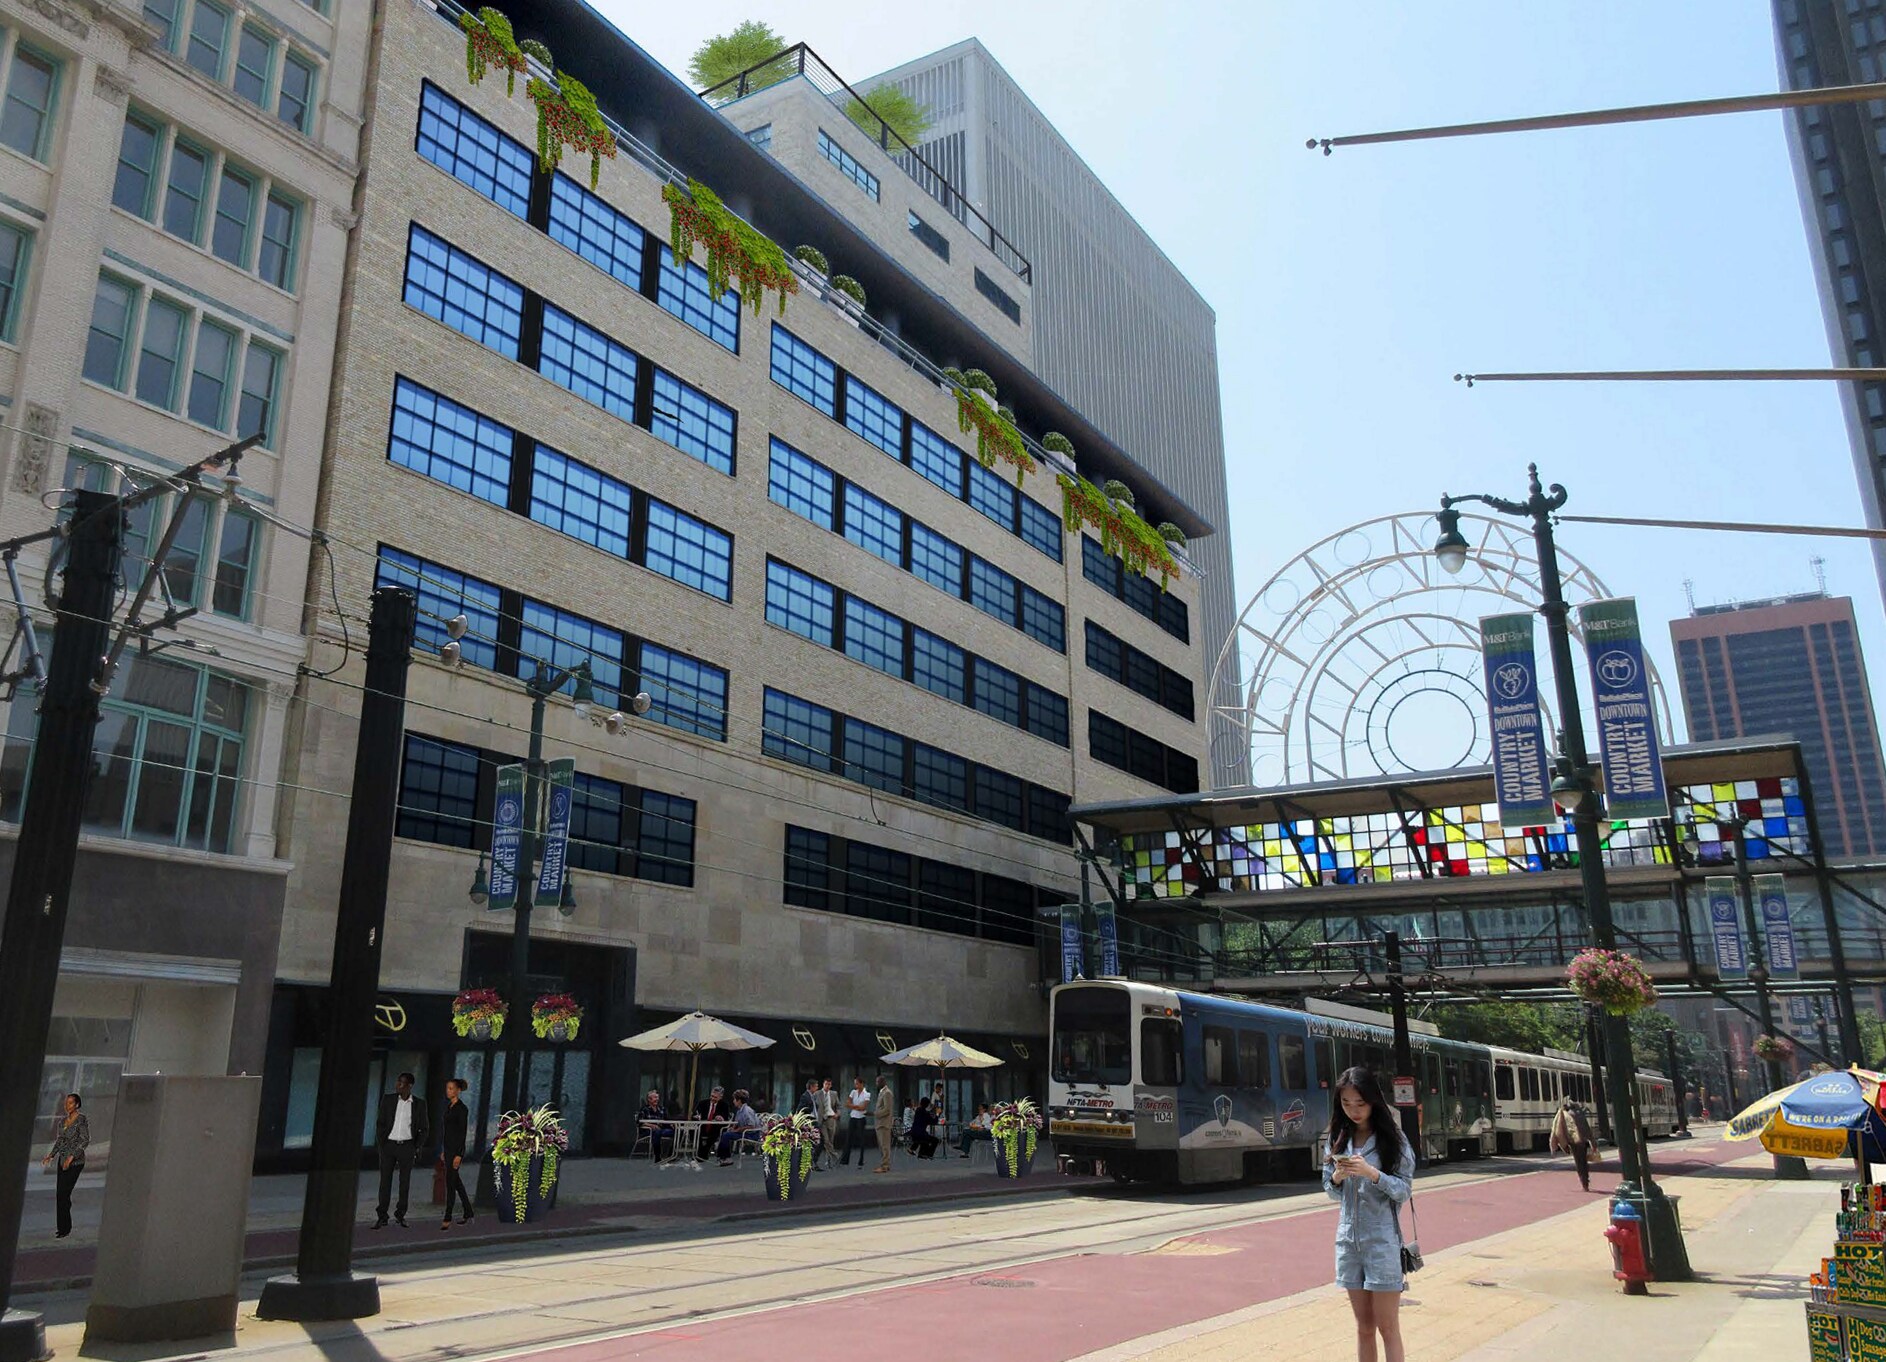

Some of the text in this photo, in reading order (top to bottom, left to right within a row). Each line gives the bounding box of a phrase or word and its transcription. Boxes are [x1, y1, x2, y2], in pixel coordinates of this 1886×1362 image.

[1599, 703, 1648, 720] DOWNTOWN
[1494, 713, 1537, 731] DOWNTOWN
[1516, 731, 1544, 801] MARKET
[1604, 722, 1632, 794] COUNTRY
[1623, 721, 1656, 793] MARKET
[1498, 733, 1522, 803] COUNTRY
[1155, 1112, 1173, 1122] 104
[1814, 1115, 1825, 1123] ON
[1836, 1246, 1882, 1258] HOT
